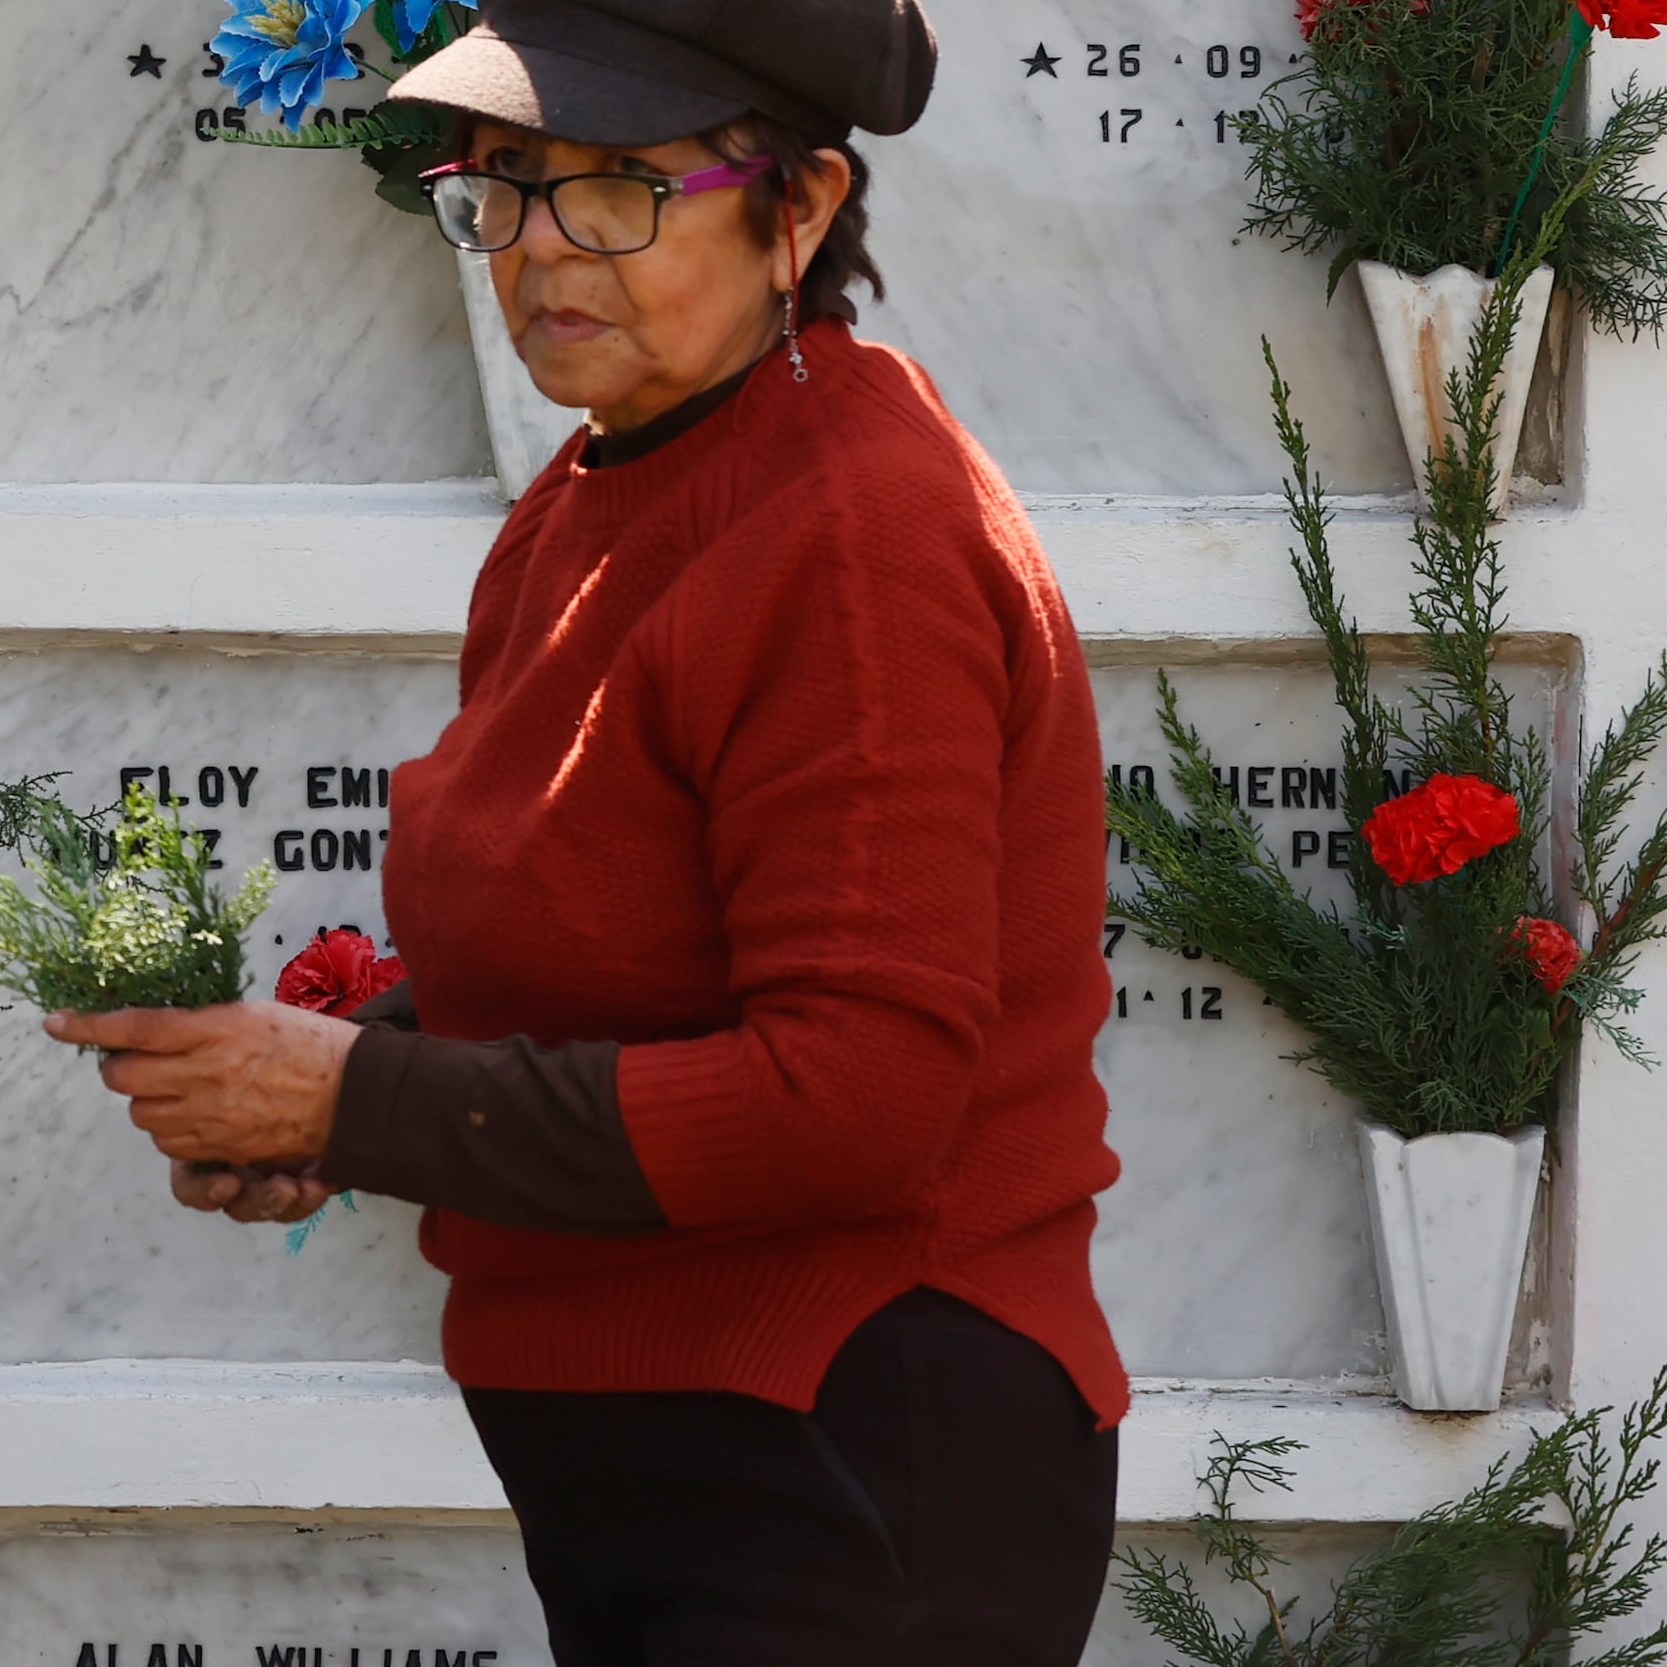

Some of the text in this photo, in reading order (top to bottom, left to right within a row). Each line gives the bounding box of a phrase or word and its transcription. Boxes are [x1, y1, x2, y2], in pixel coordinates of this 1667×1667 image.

[1086, 43, 1262, 79] 26 09
[1099, 108, 1143, 144] 17
[120, 765, 259, 808] ELOY
[1212, 765, 1411, 810] HERNN
[1180, 985, 1223, 1021] 12
